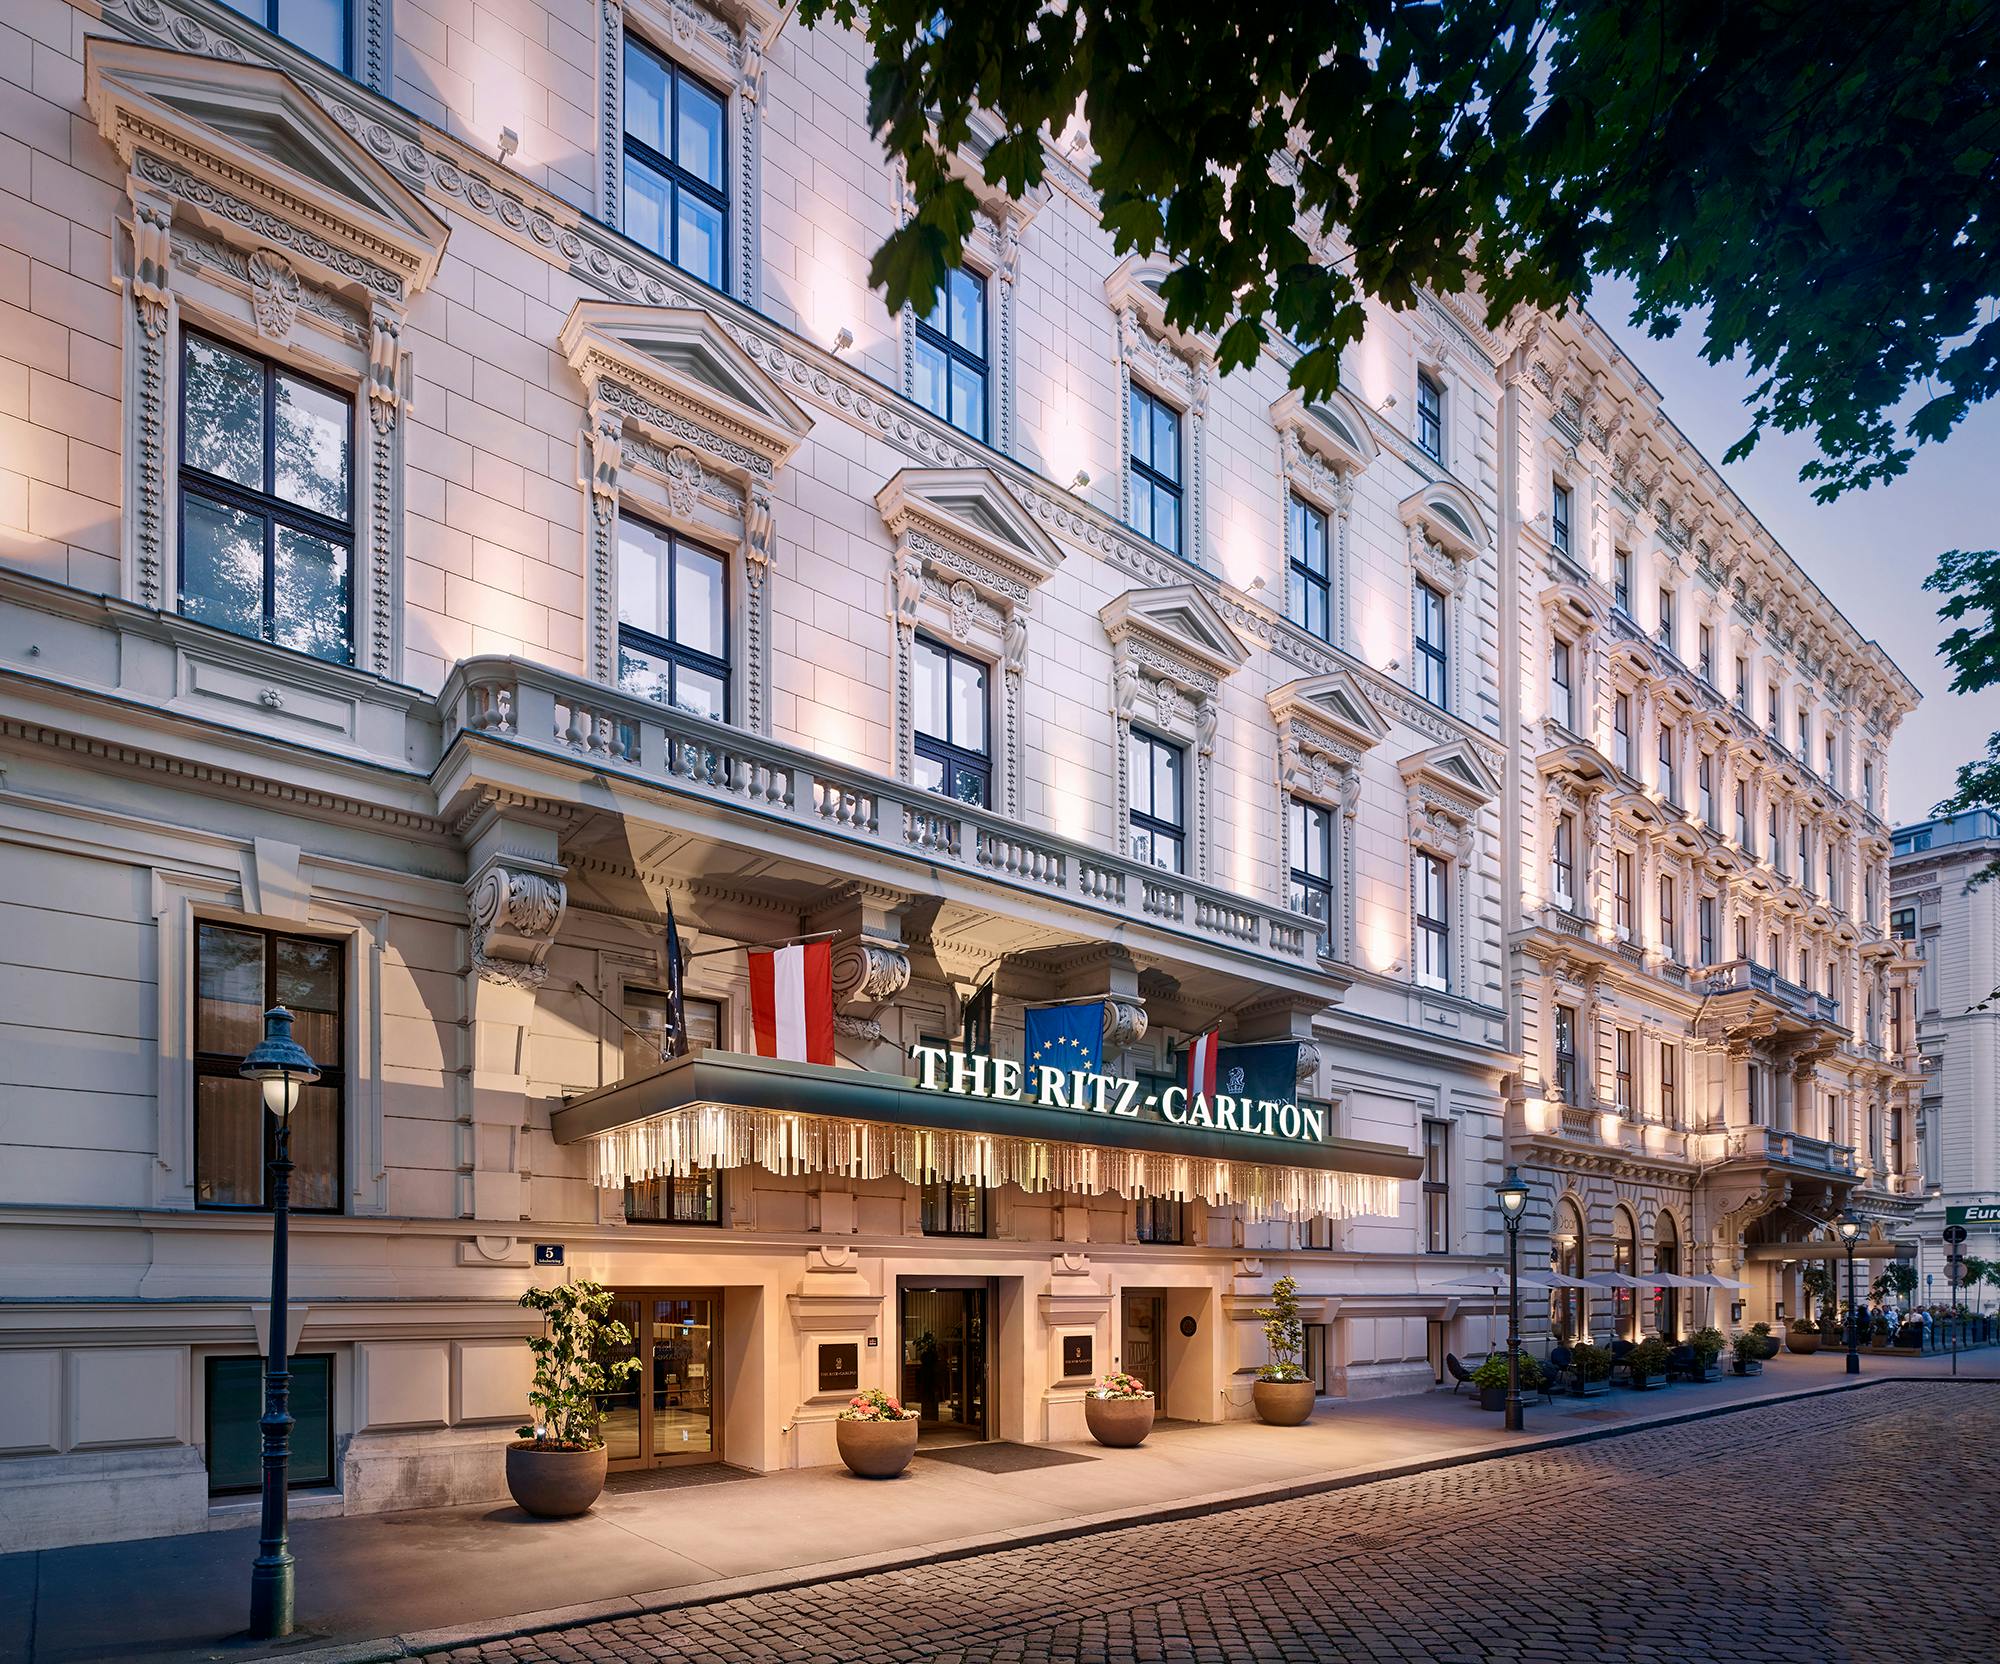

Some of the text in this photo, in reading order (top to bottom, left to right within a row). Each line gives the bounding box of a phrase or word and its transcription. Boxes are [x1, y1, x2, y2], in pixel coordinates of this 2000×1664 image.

[911, 1044, 1325, 1143] THE RITZ-CARLTON
[545, 1247, 554, 1259] 5
